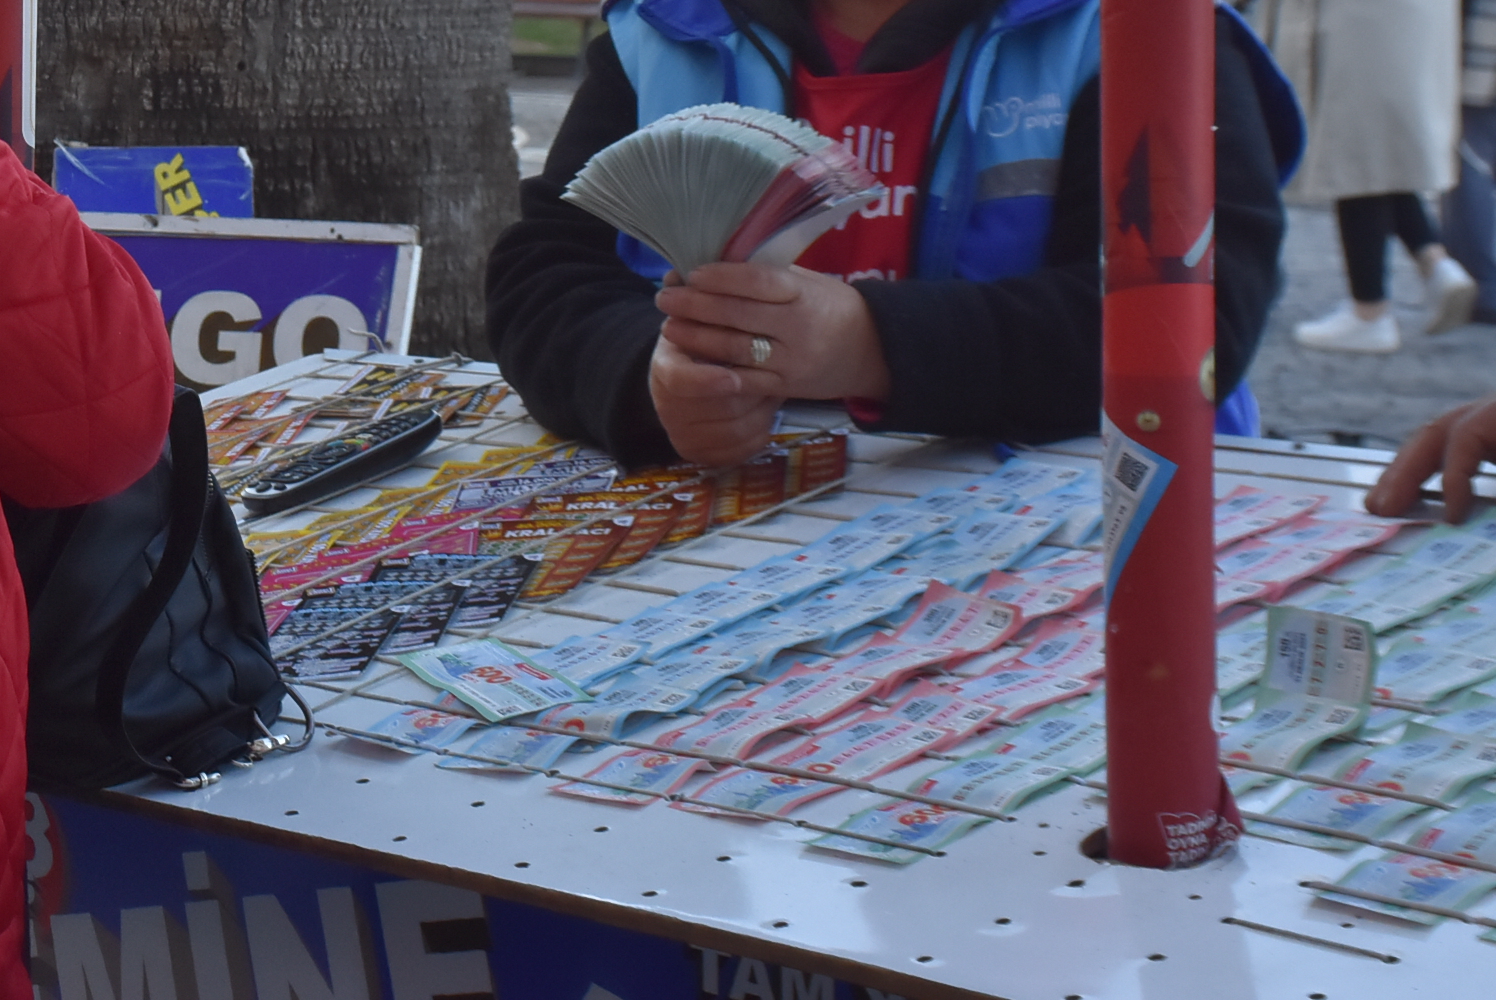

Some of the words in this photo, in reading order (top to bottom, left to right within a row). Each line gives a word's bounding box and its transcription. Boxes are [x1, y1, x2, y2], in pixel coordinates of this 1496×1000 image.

[842, 124, 895, 173] illi
[153, 152, 210, 216] ER
[169, 289, 370, 386] GO
[565, 501, 621, 511] KRAL
[635, 502, 674, 510] ACI
[504, 527, 559, 539] KRAL
[574, 527, 612, 536] ACI
[471, 665, 513, 684] 600
